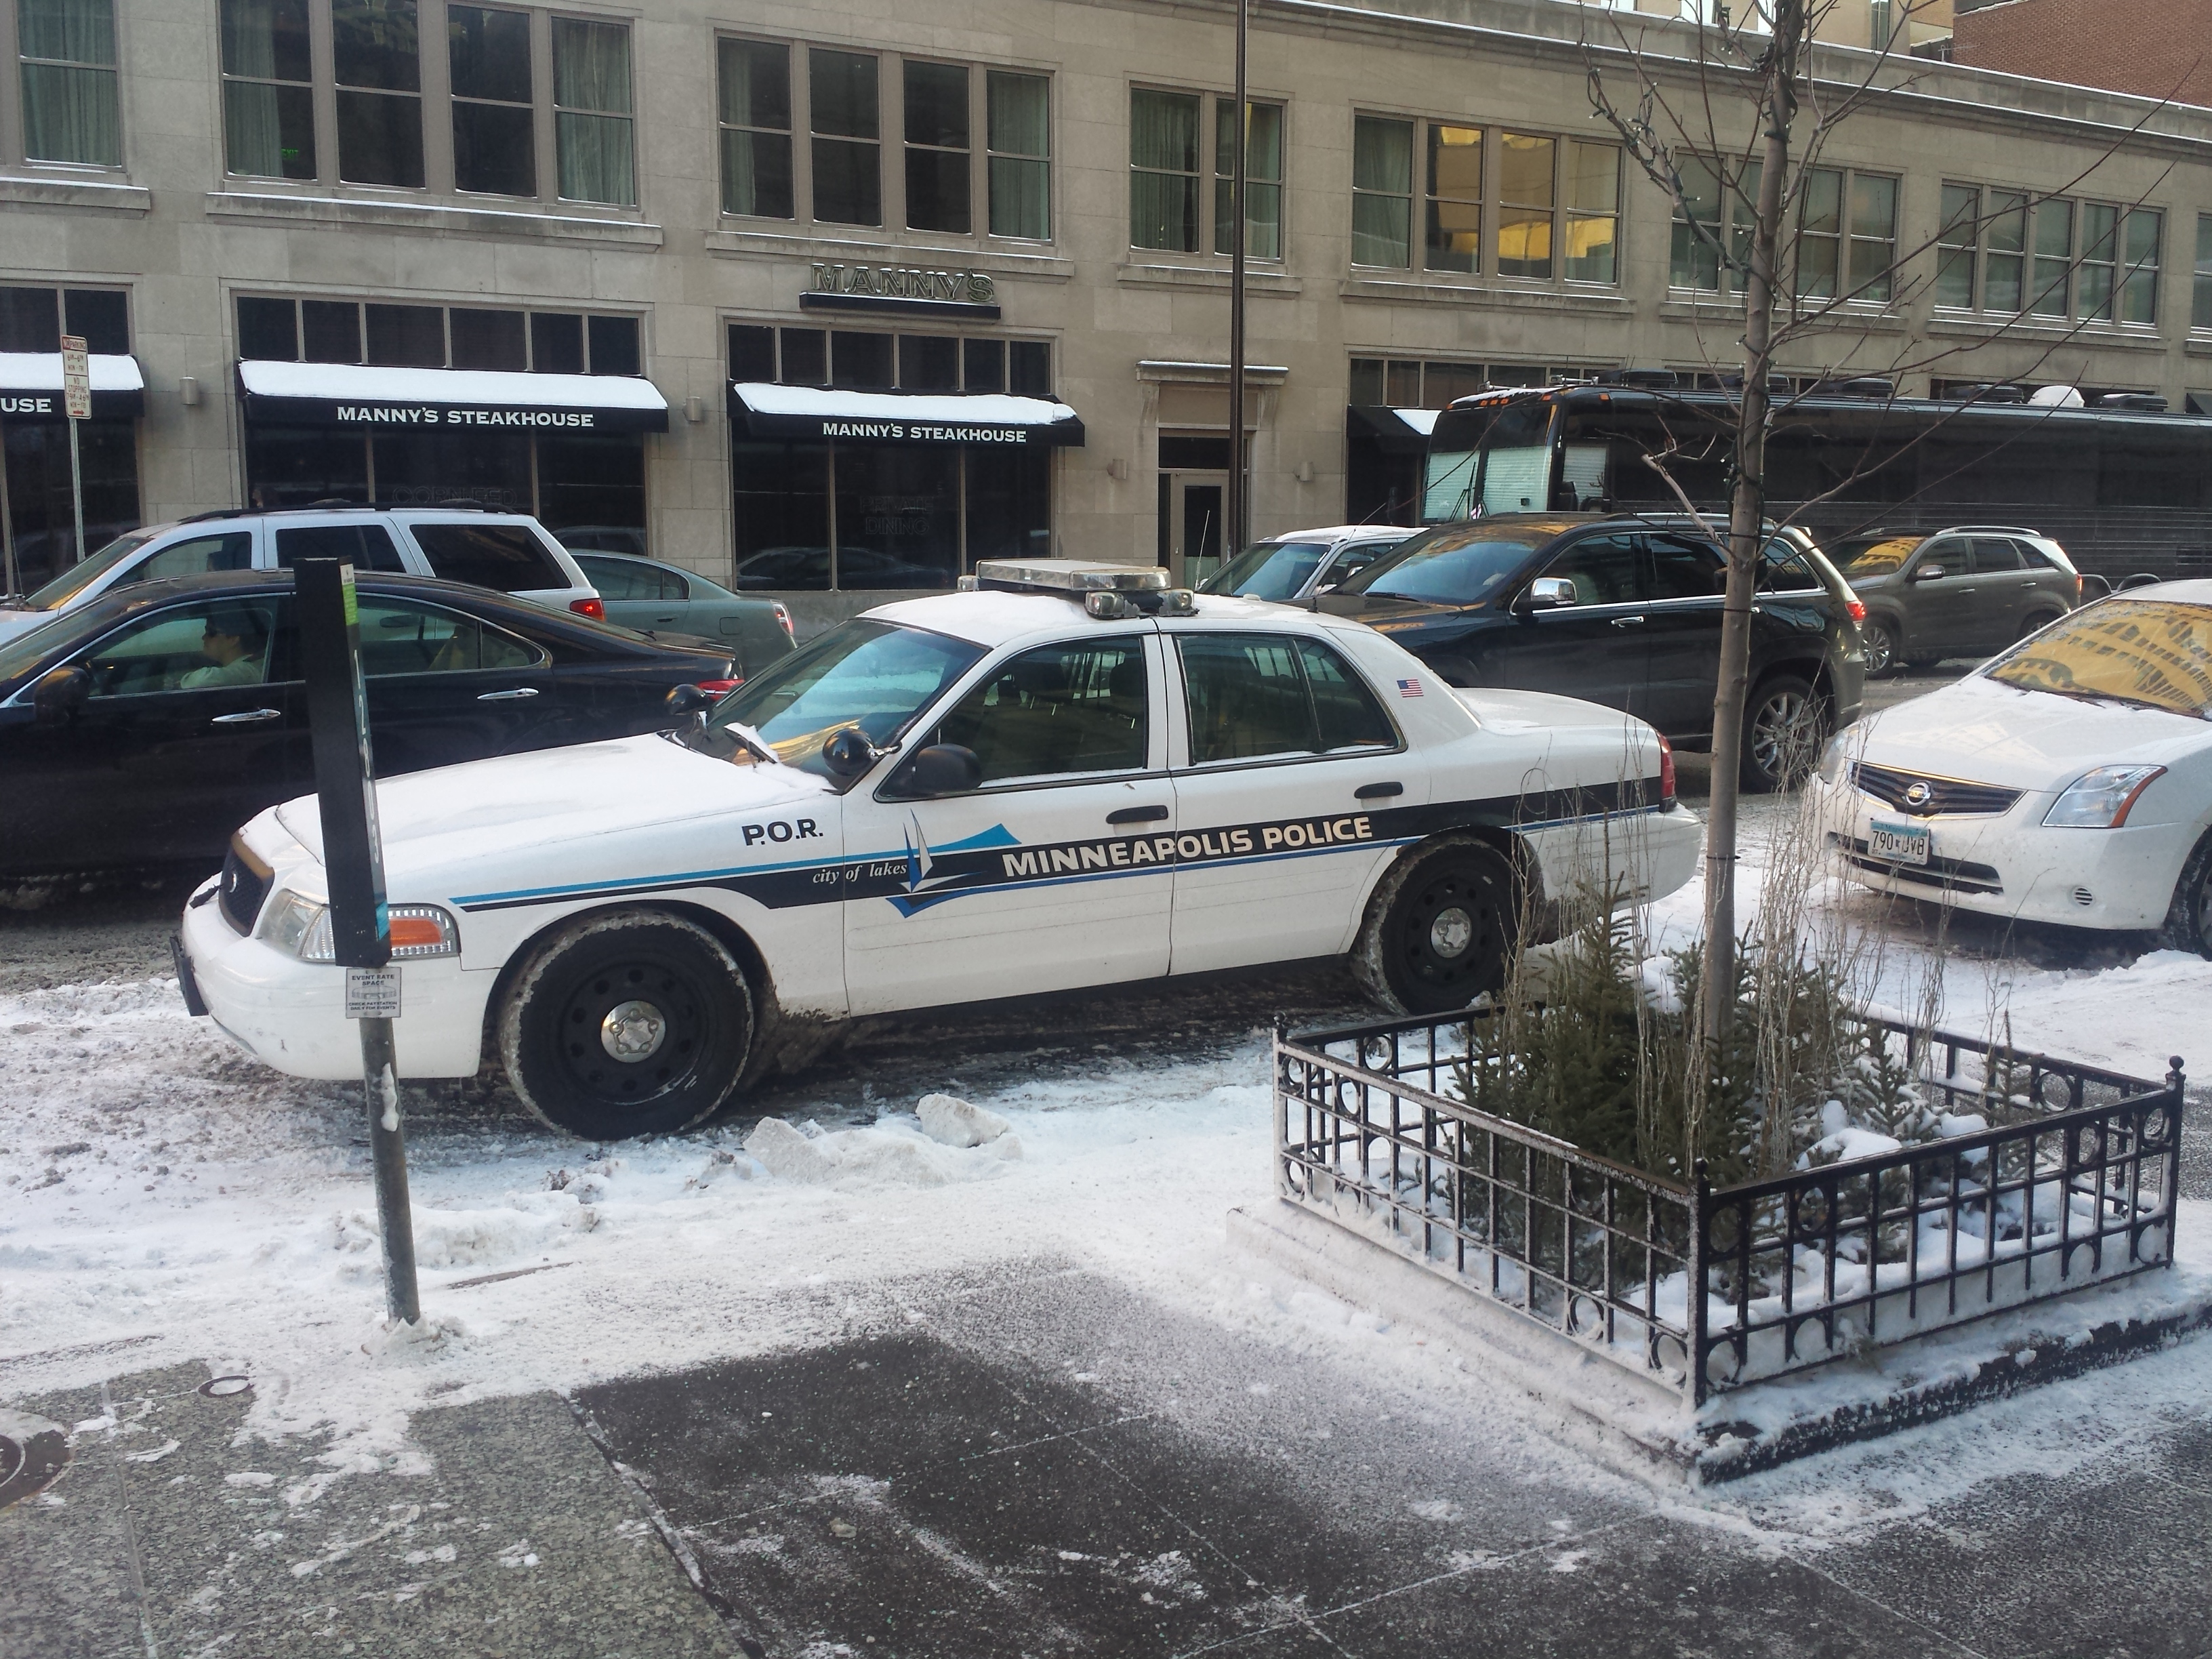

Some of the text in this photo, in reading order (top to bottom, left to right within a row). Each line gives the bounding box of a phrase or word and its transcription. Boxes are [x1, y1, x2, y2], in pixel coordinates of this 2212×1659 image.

[811, 264, 994, 302] MANNY'S
[68, 385, 86, 393] STOPPING
[0, 398, 52, 413] USE
[337, 407, 594, 427] MANNY'S STEAKHOUSE
[823, 422, 1027, 443] MANNY'S STEAKHOUSE
[859, 496, 934, 514] PRIVATE
[865, 517, 930, 535] DINING
[741, 818, 824, 846] P.O.R.
[1002, 817, 1373, 877] MINNEAPOLIS POLICE
[813, 863, 907, 884] city of lakes
